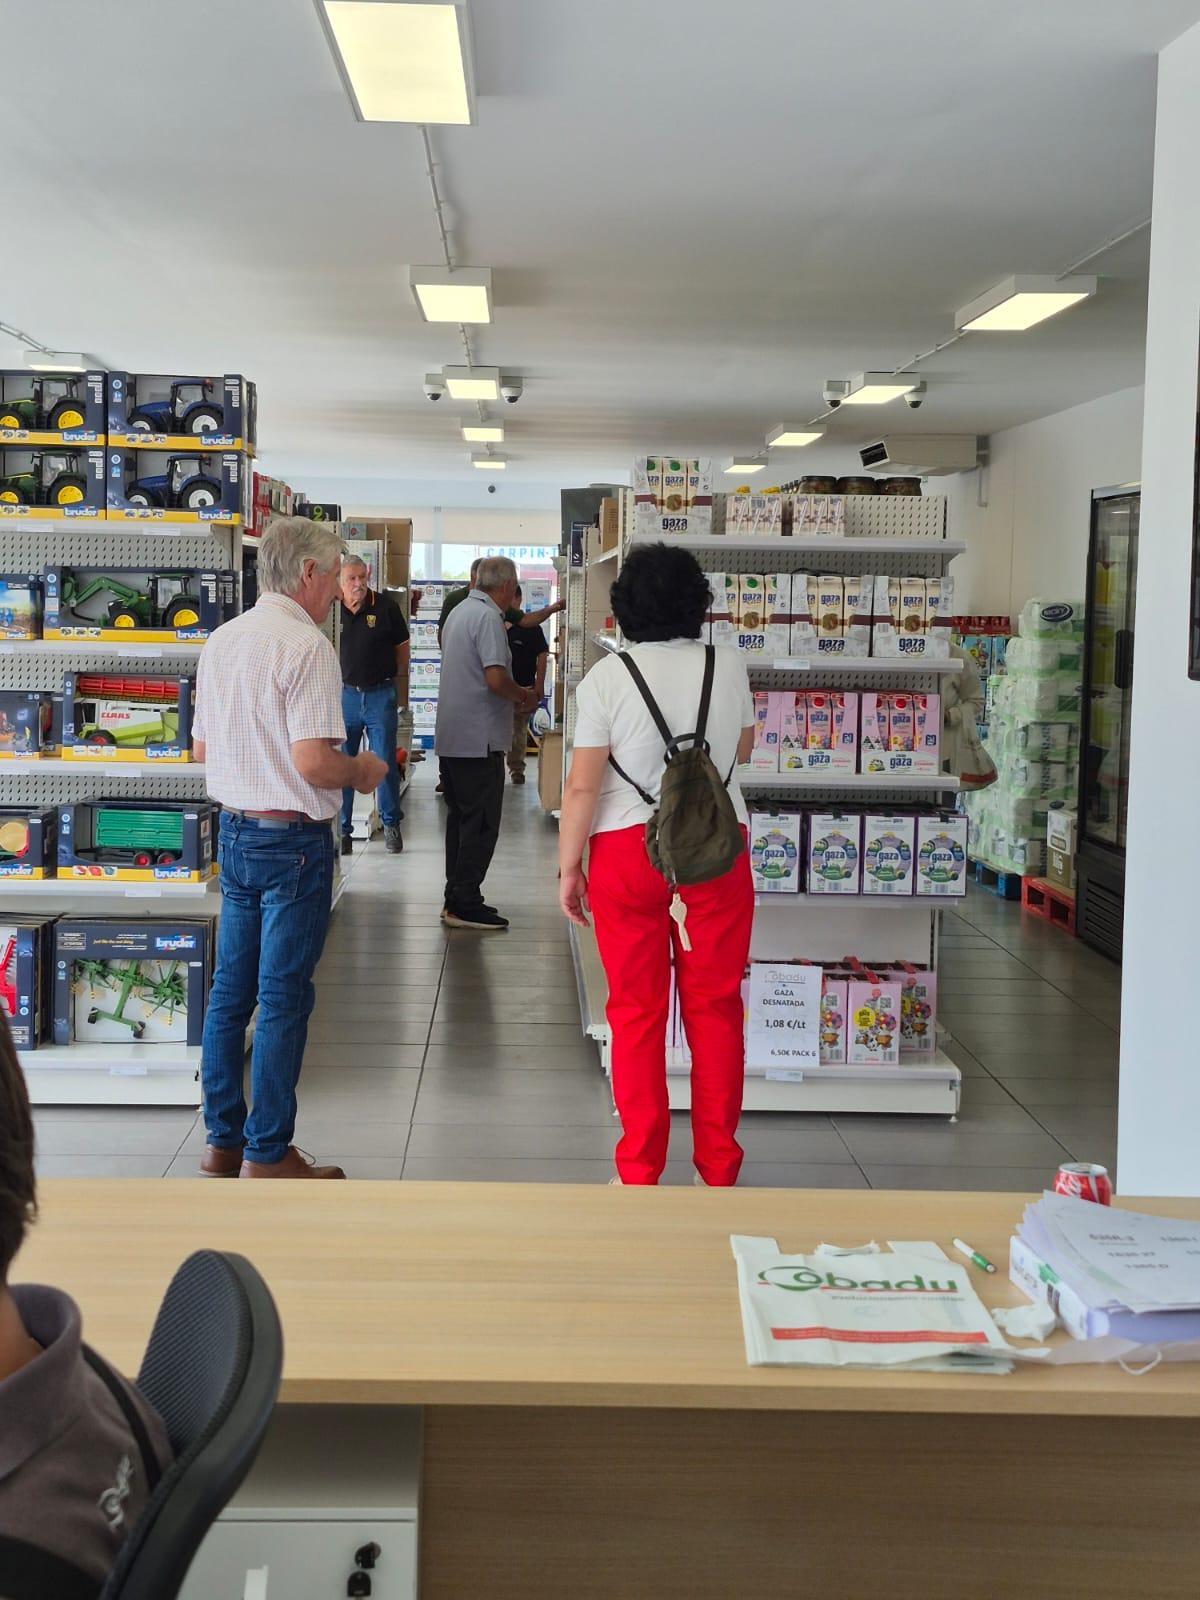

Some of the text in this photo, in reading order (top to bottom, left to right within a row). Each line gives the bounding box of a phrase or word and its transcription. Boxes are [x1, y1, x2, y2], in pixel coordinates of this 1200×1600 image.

[63, 431, 97, 442] bruder
[200, 434, 234, 446] bruder
[64, 507, 97, 518] bruder
[199, 510, 232, 521] bruder
[662, 517, 688, 530] gaza
[742, 592, 762, 603] gaza
[820, 594, 841, 605] gaza
[903, 595, 923, 606] gaza
[176, 630, 209, 640] bruder
[738, 634, 765, 648] gaza
[818, 638, 845, 652] gaza
[898, 637, 926, 651] gaza
[101, 711, 130, 720] CLAAS
[810, 713, 829, 724] gaza
[892, 714, 911, 725] gaza
[147, 747, 181, 758] bruder
[807, 752, 831, 767] gaza
[890, 755, 912, 769] gaza
[764, 849, 786, 860] gaza
[824, 850, 846, 861] gaza
[878, 851, 899, 862] gaza
[931, 852, 953, 863] gaza
[154, 867, 191, 879] bruder
[155, 937, 195, 949] bruder
[774, 989, 794, 997] GAZA
[762, 998, 805, 1008] DESNATADA
[765, 1018, 806, 1030] 1,08 €/Lt
[770, 1049, 790, 1058] 6,50€
